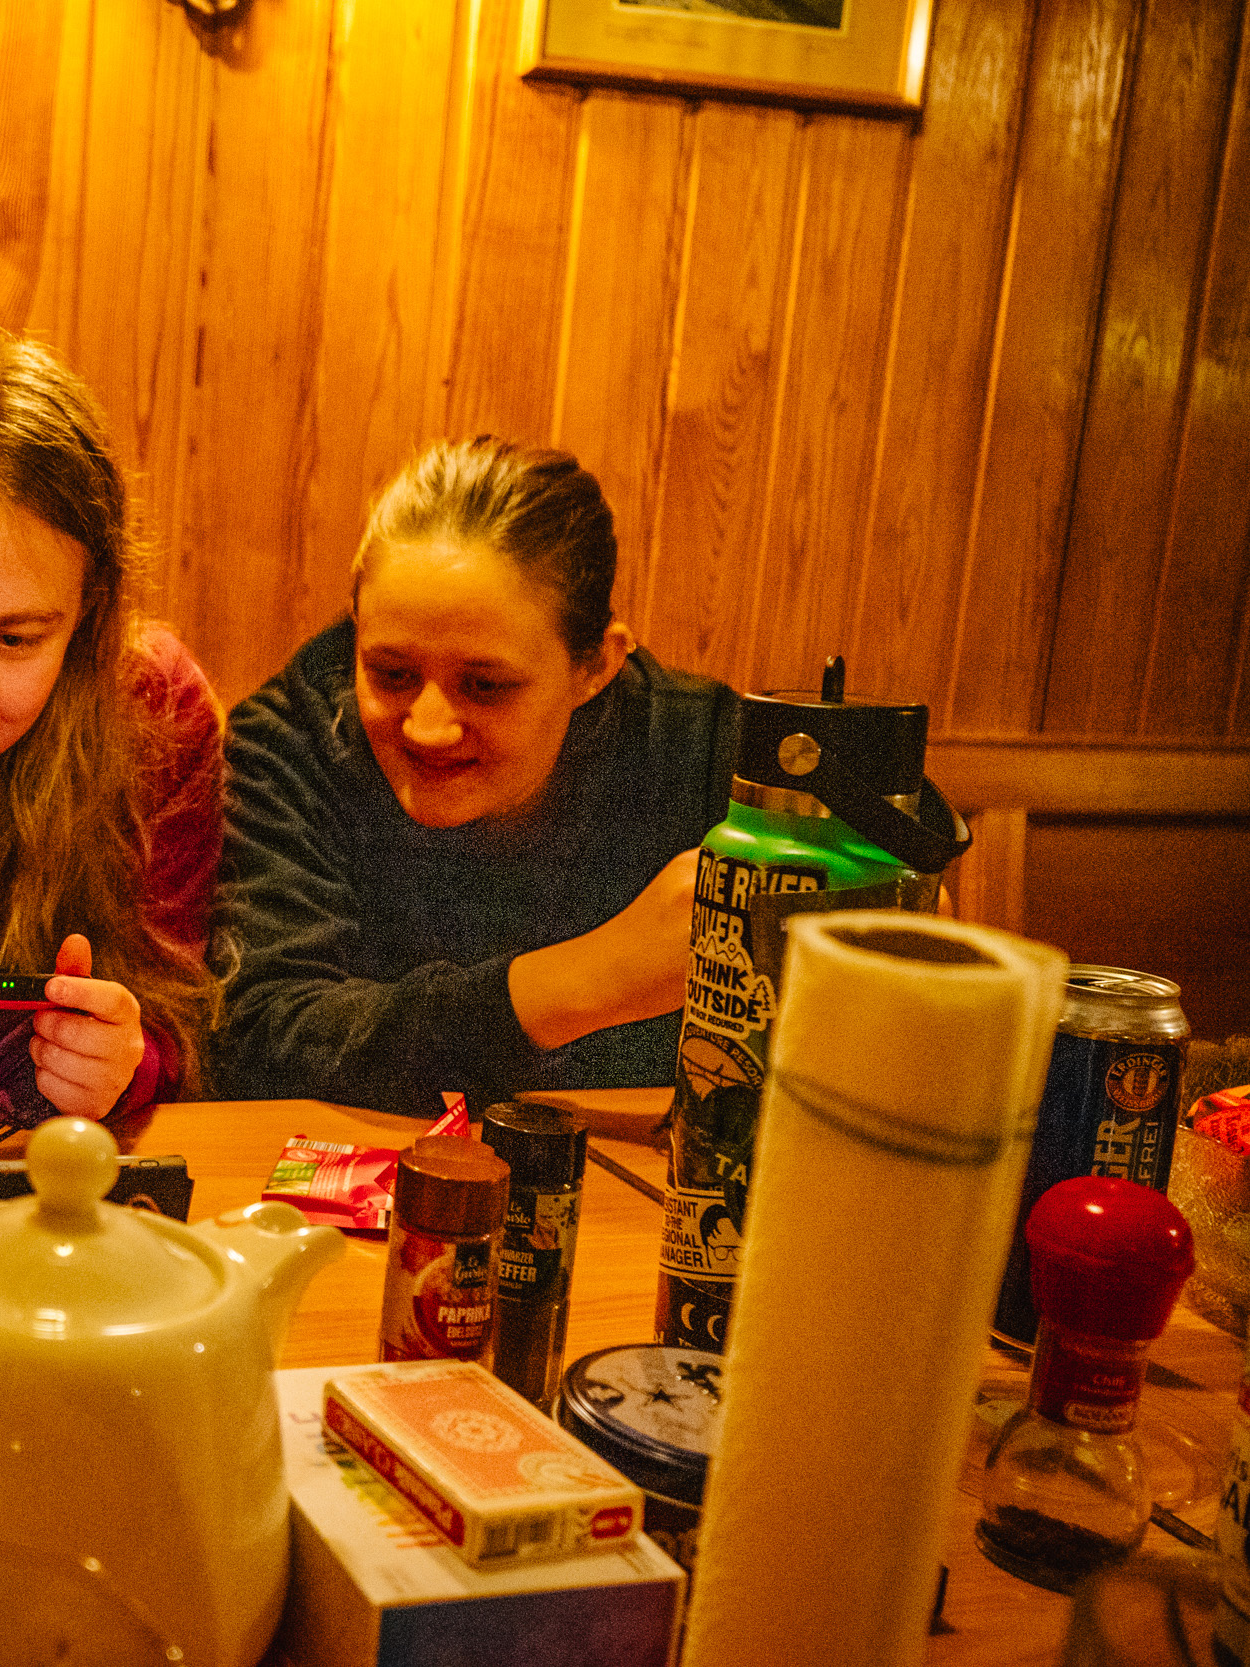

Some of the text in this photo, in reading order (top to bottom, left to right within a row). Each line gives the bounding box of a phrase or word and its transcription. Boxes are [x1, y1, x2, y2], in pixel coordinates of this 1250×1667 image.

[698, 855, 728, 904] THE
[696, 955, 748, 992] THINK
[688, 976, 762, 1024] OUTSIDE
[1137, 1121, 1159, 1187] FREI
